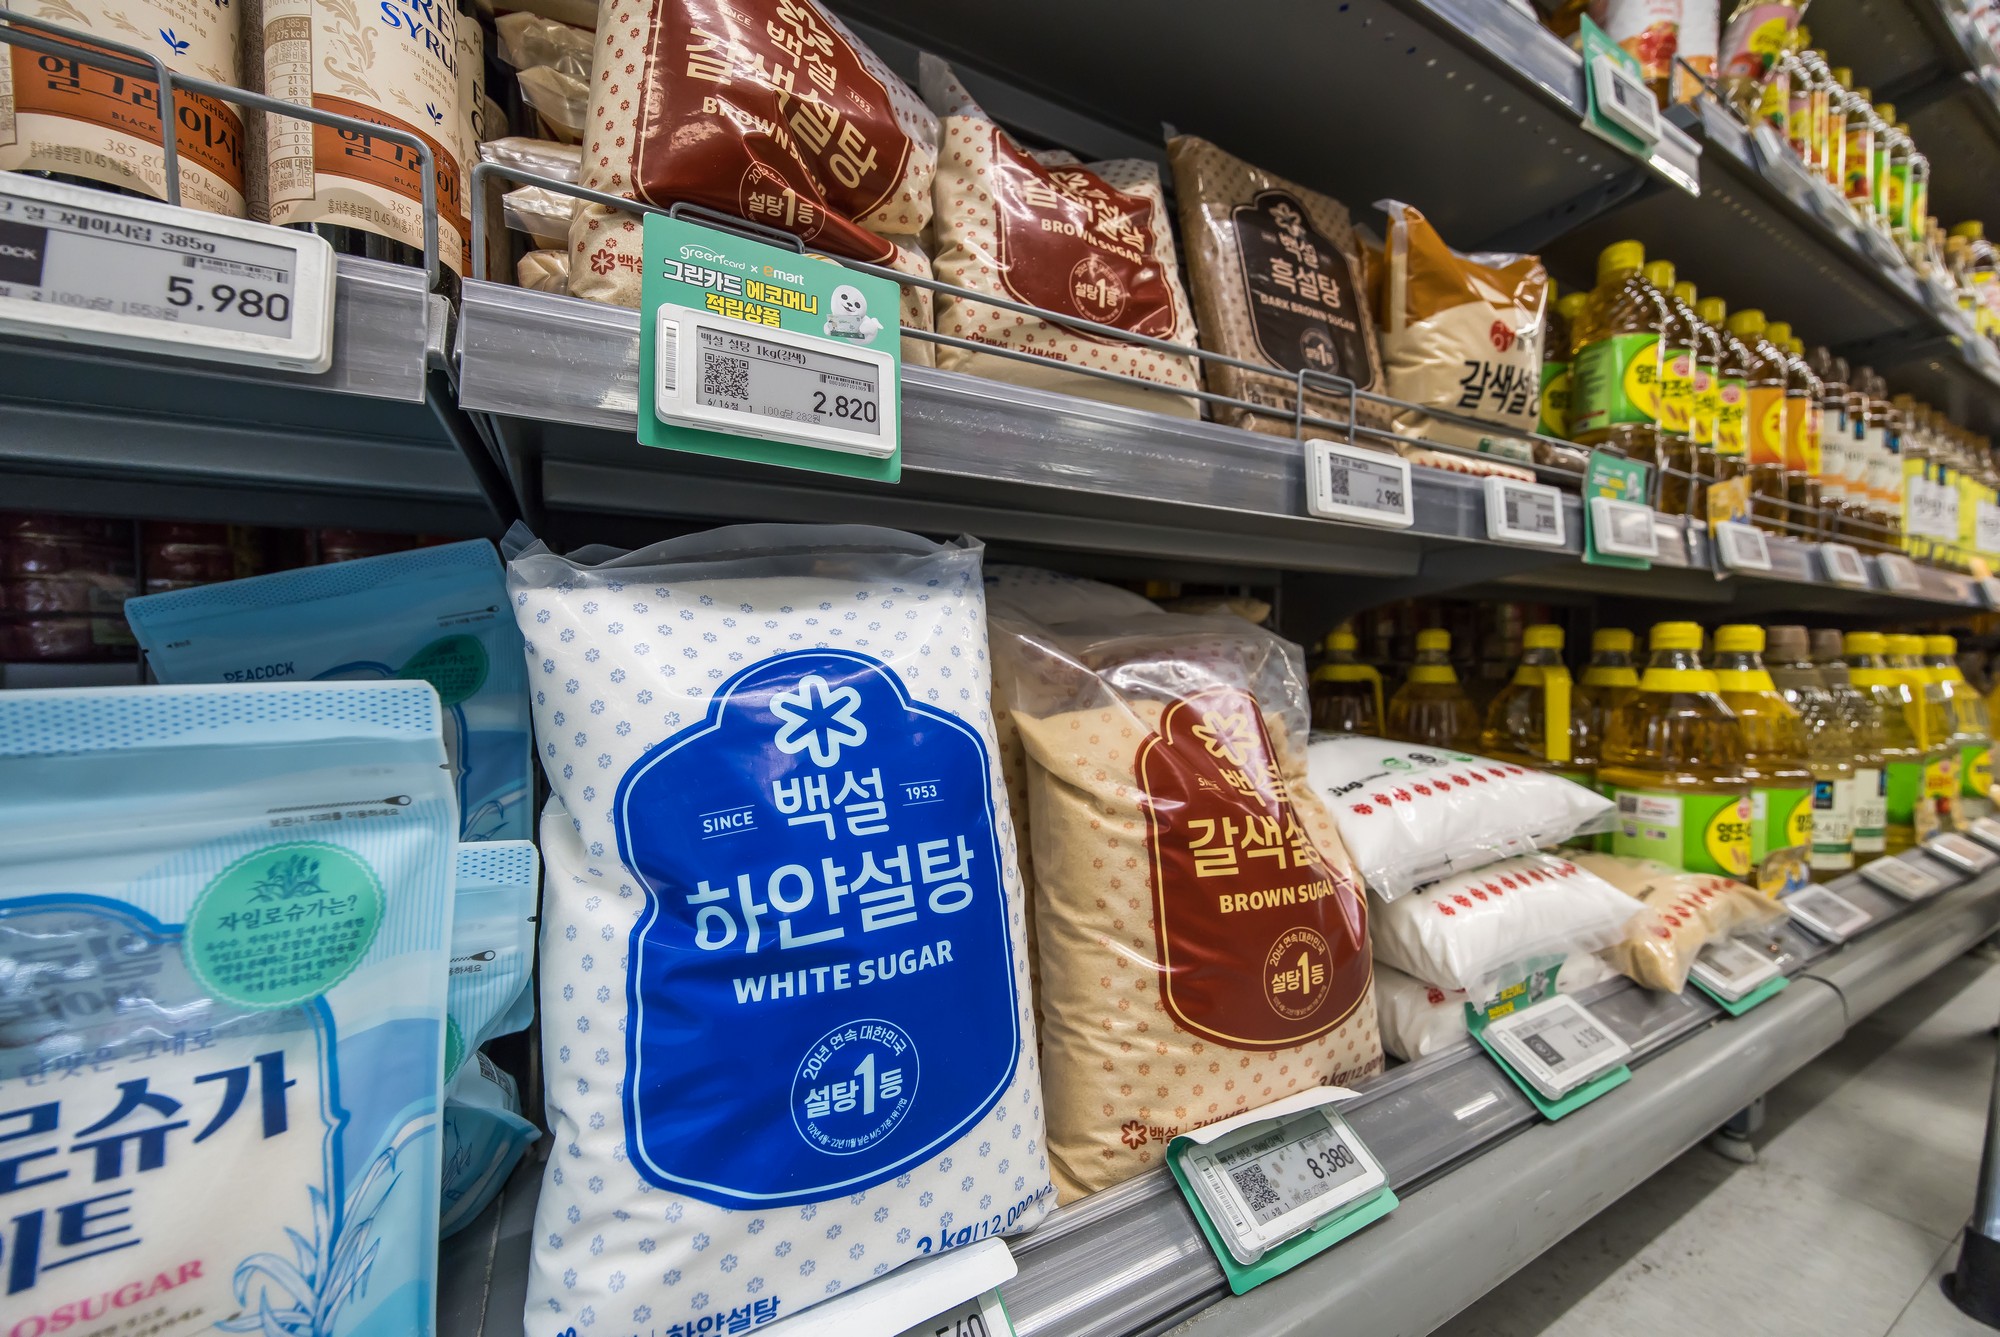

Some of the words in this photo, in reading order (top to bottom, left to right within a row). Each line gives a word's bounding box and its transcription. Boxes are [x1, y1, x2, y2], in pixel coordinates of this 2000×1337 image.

[290, 28, 309, 38] kcal
[381, 0, 459, 80] SYRUP
[766, 19, 838, 97] 백설
[849, 90, 872, 114] 1953
[111, 111, 157, 133] BLACK
[103, 139, 137, 158] 385
[328, 198, 372, 222] 홍차추출분말
[388, 199, 412, 217] 385
[161, 231, 216, 254] 385g
[662, 257, 743, 296] 그린카드
[745, 278, 819, 315] 에코머니
[763, 265, 804, 286] emart
[1268, 256, 1342, 310] 흑설탕
[166, 275, 290, 323] 5,980
[704, 292, 781, 329] 적립상품
[700, 331, 724, 347] 백설
[728, 338, 751, 354] 설탕
[1456, 360, 1540, 420] 갈색설
[813, 391, 877, 423] 2,820
[223, 661, 295, 684] PEACOCK
[772, 767, 890, 841] 백설
[905, 785, 938, 801] 1953
[702, 811, 754, 833] SINCE
[686, 835, 975, 954] 하얀설탕
[1219, 887, 1296, 914] BROWN
[216, 894, 358, 933] 자일로슈가는?
[732, 963, 852, 1004] WHITE
[858, 939, 954, 986] SUGAR
[802, 1044, 833, 1081] 20년
[830, 1028, 858, 1052] 연속
[860, 1024, 908, 1057] 대한민국
[1306, 1144, 1355, 1179] 8,380
